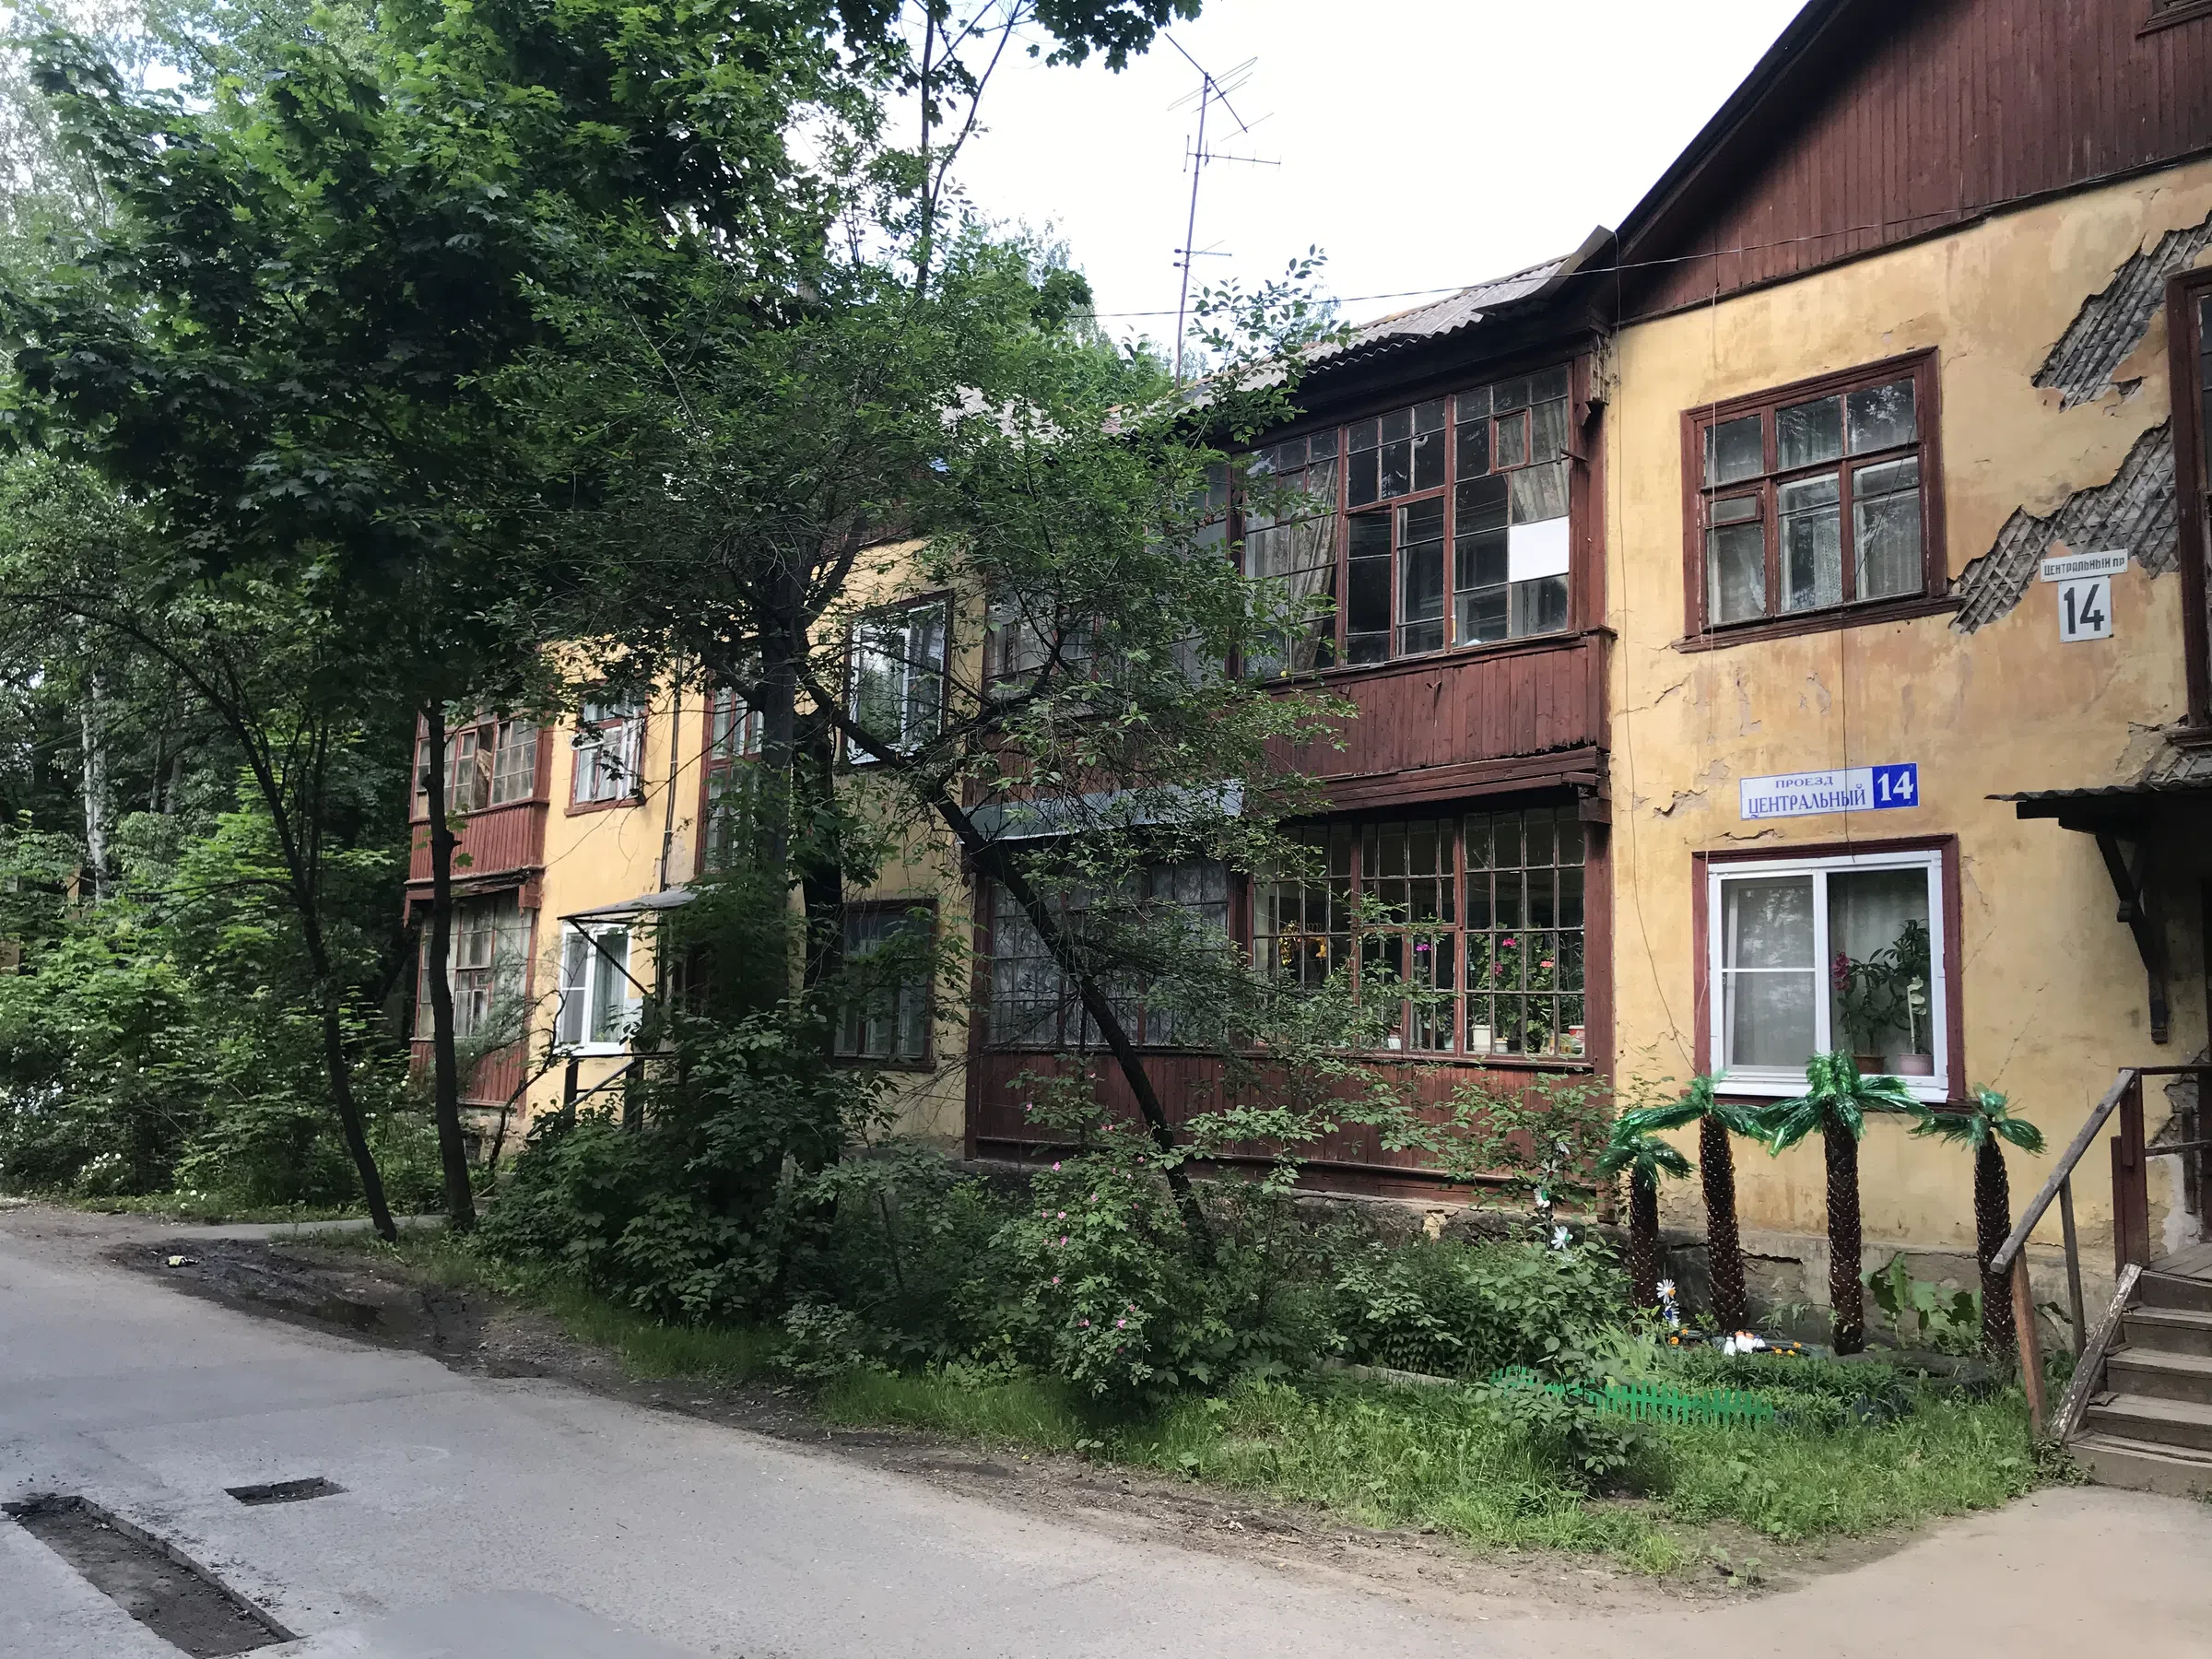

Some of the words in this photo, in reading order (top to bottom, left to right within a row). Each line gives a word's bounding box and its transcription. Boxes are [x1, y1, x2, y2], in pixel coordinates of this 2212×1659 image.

[2064, 583, 2105, 634] 14
[1775, 776, 1833, 789] ПРОЕЗД
[1877, 771, 1913, 802] 14
[1748, 783, 1866, 818] ЦЕНТРАЛЬНЫЙ
